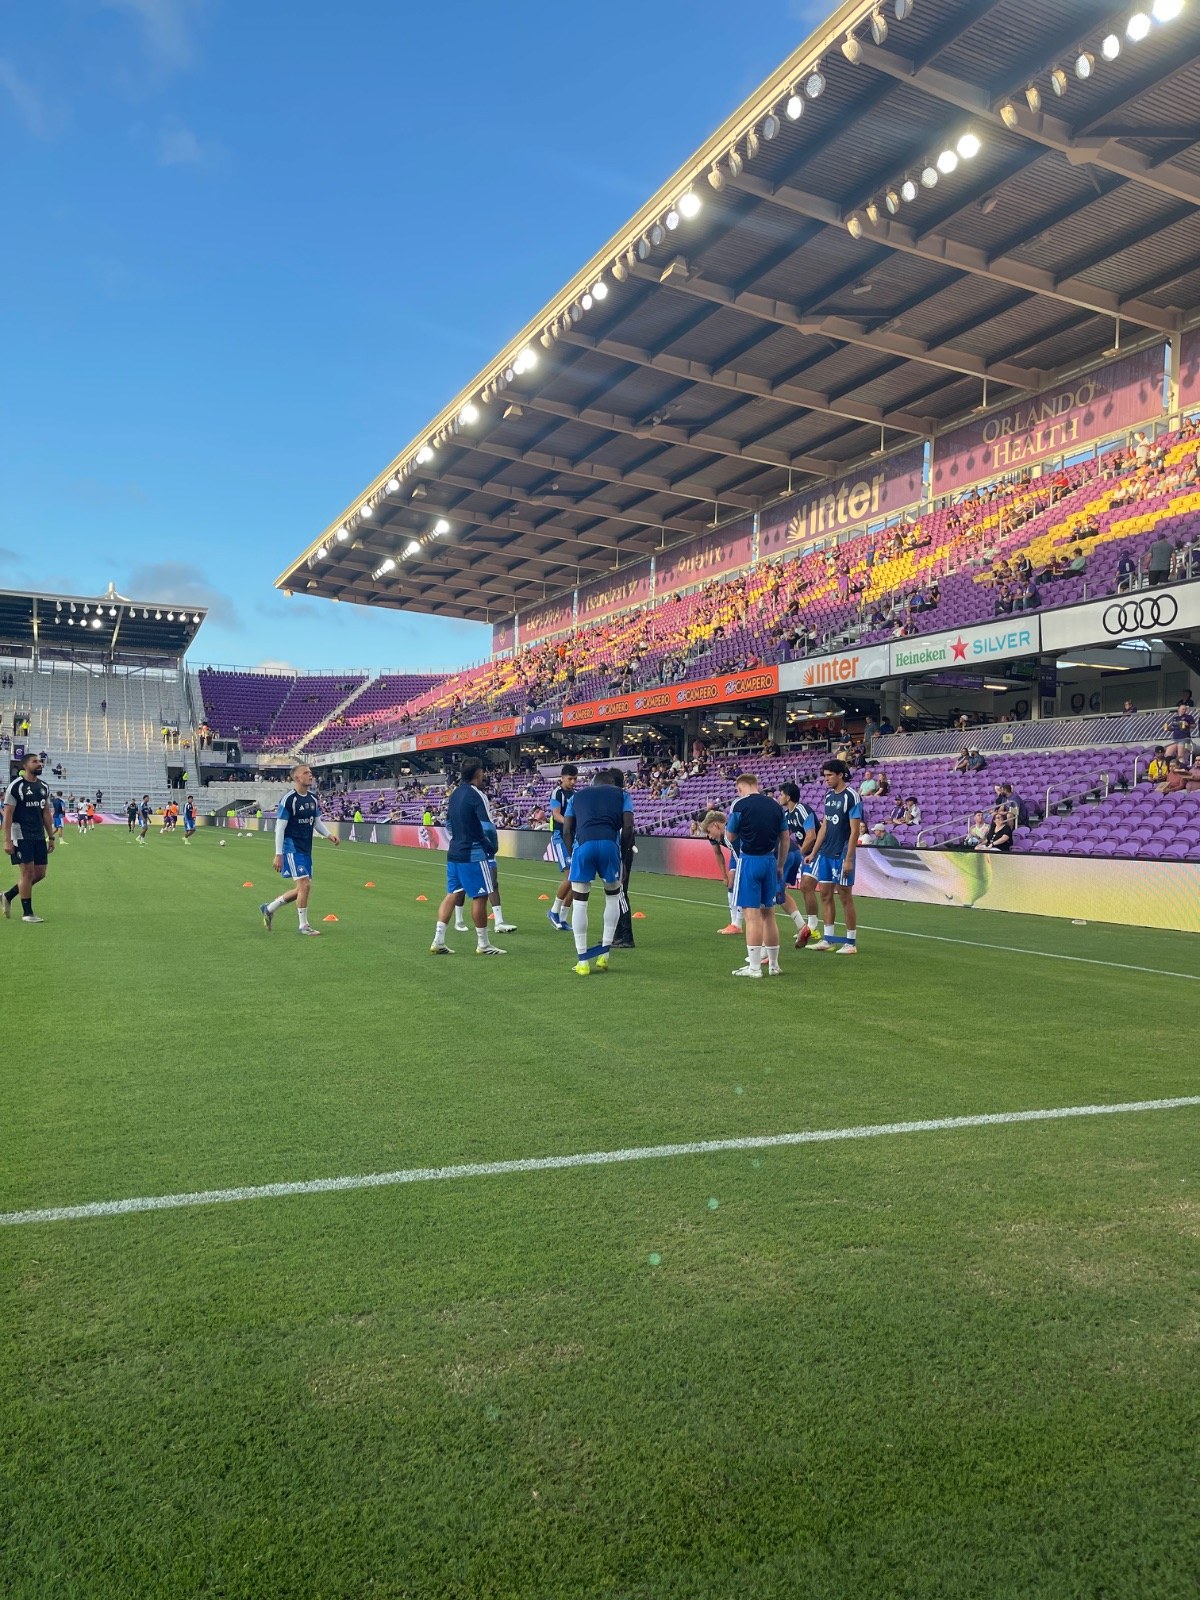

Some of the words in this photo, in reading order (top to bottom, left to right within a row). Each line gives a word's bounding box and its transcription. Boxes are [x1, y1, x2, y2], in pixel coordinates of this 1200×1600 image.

[983, 384, 1095, 444] ORLANDO
[993, 417, 1079, 469] HEALTH
[810, 473, 885, 535] inter
[896, 648, 946, 667] Heineken
[973, 630, 1031, 654] SILVER
[735, 674, 773, 693] CAMPERO
[817, 656, 859, 684] inter
[685, 684, 718, 702] CAMPERO
